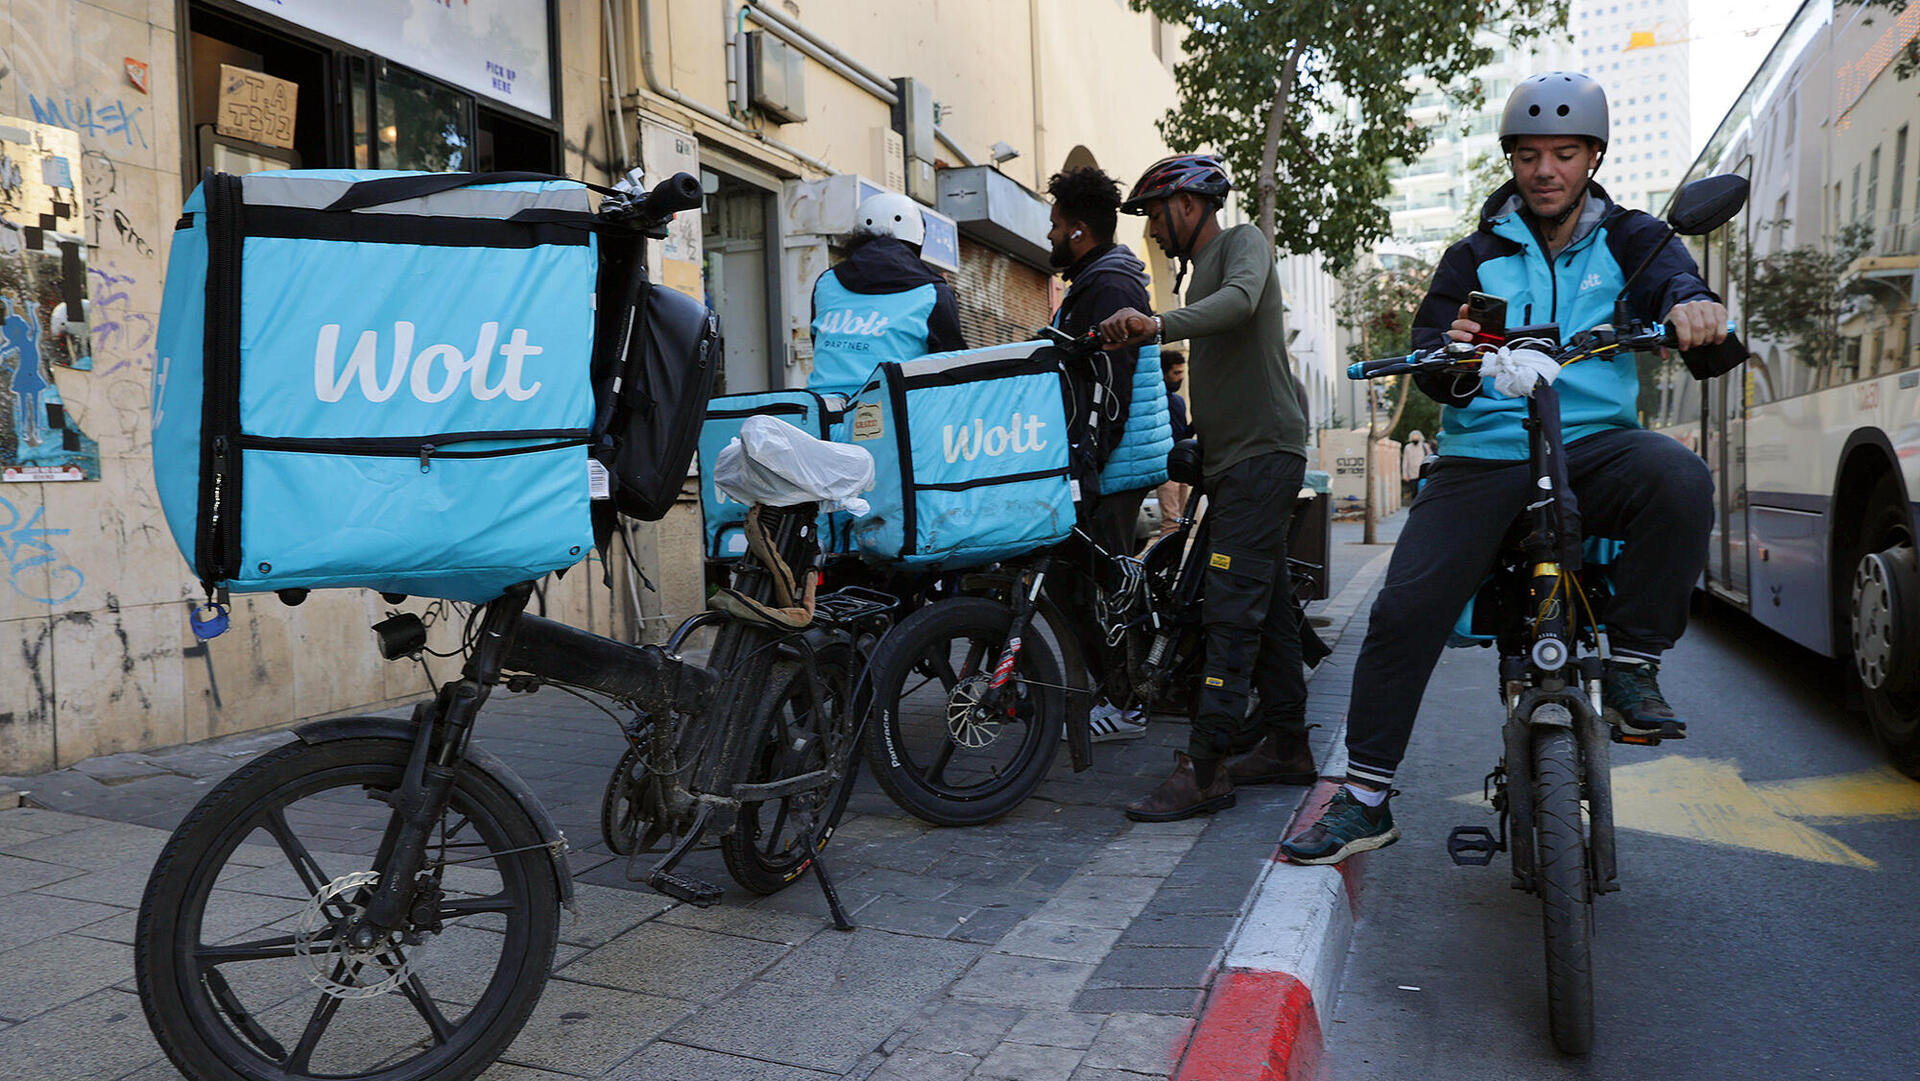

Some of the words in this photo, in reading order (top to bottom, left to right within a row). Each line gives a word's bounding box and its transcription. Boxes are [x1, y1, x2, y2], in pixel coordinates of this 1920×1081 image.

[1580, 273, 1602, 291] olt
[819, 308, 889, 337] Wolt
[823, 340, 870, 352] PARTNER
[314, 320, 544, 404] Wolt
[942, 412, 1048, 464] Wolt
